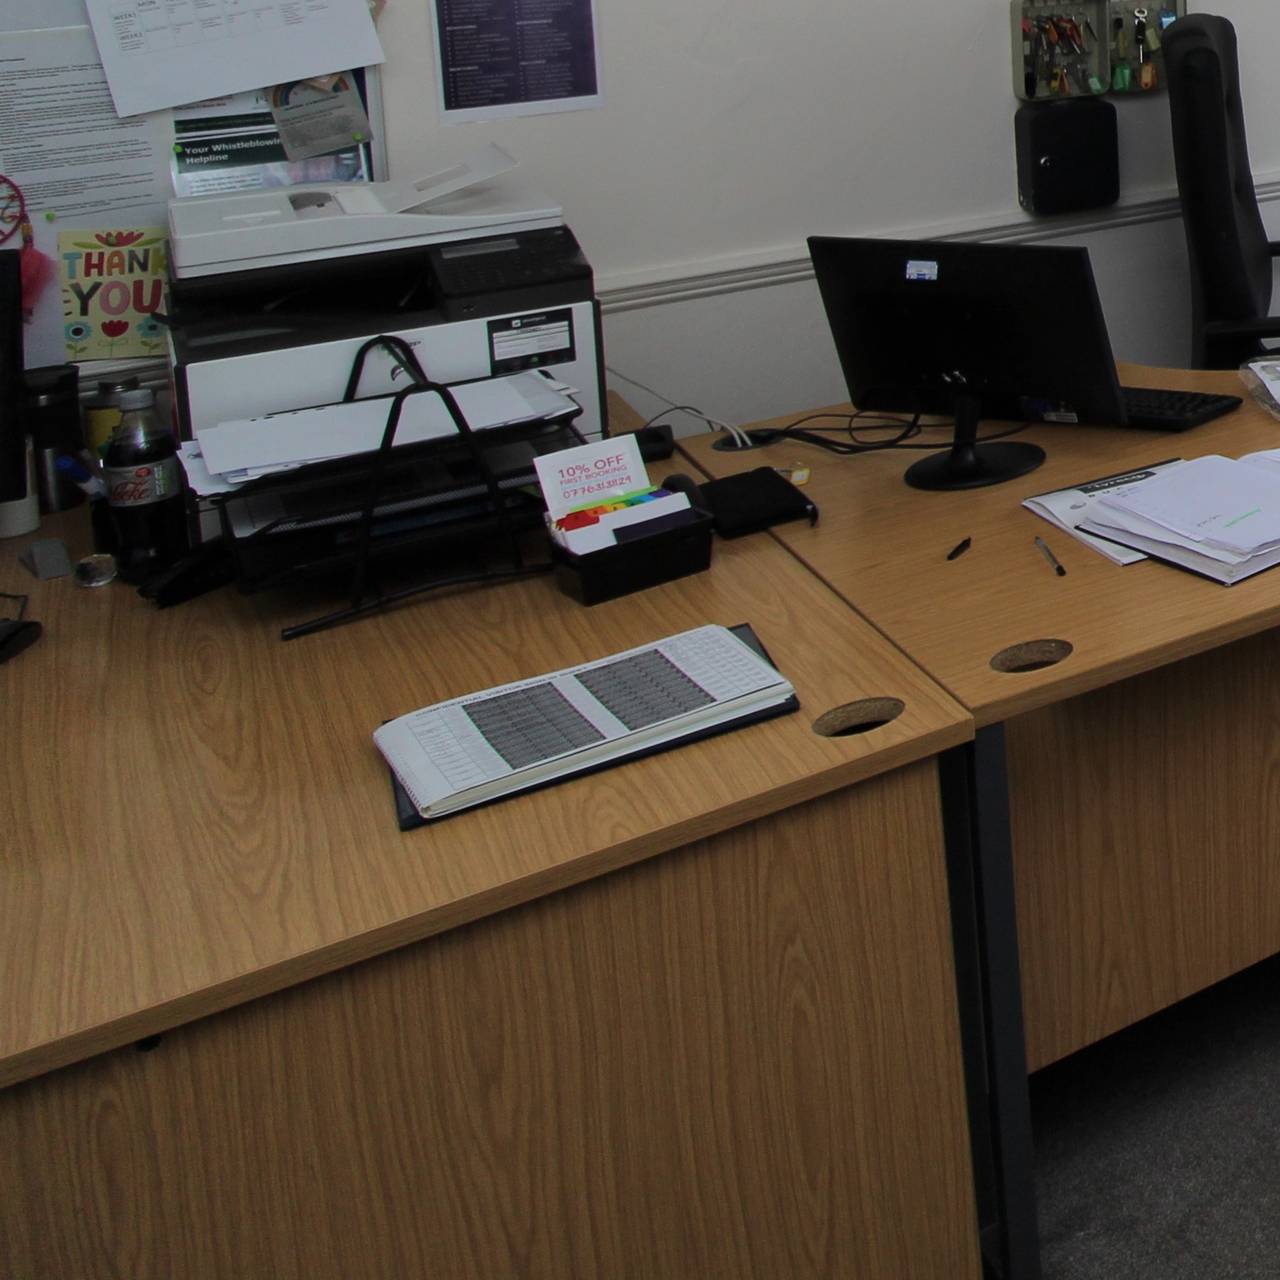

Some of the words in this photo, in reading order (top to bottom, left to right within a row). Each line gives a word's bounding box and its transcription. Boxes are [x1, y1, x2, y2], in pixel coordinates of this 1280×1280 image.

[184, 145, 208, 156] Your
[184, 153, 229, 166] Helpline
[63, 248, 166, 279] THANK
[69, 279, 162, 316] YOU
[558, 464, 591, 479] 10%
[594, 454, 624, 471] OFF
[584, 464, 628, 480] BOOKING
